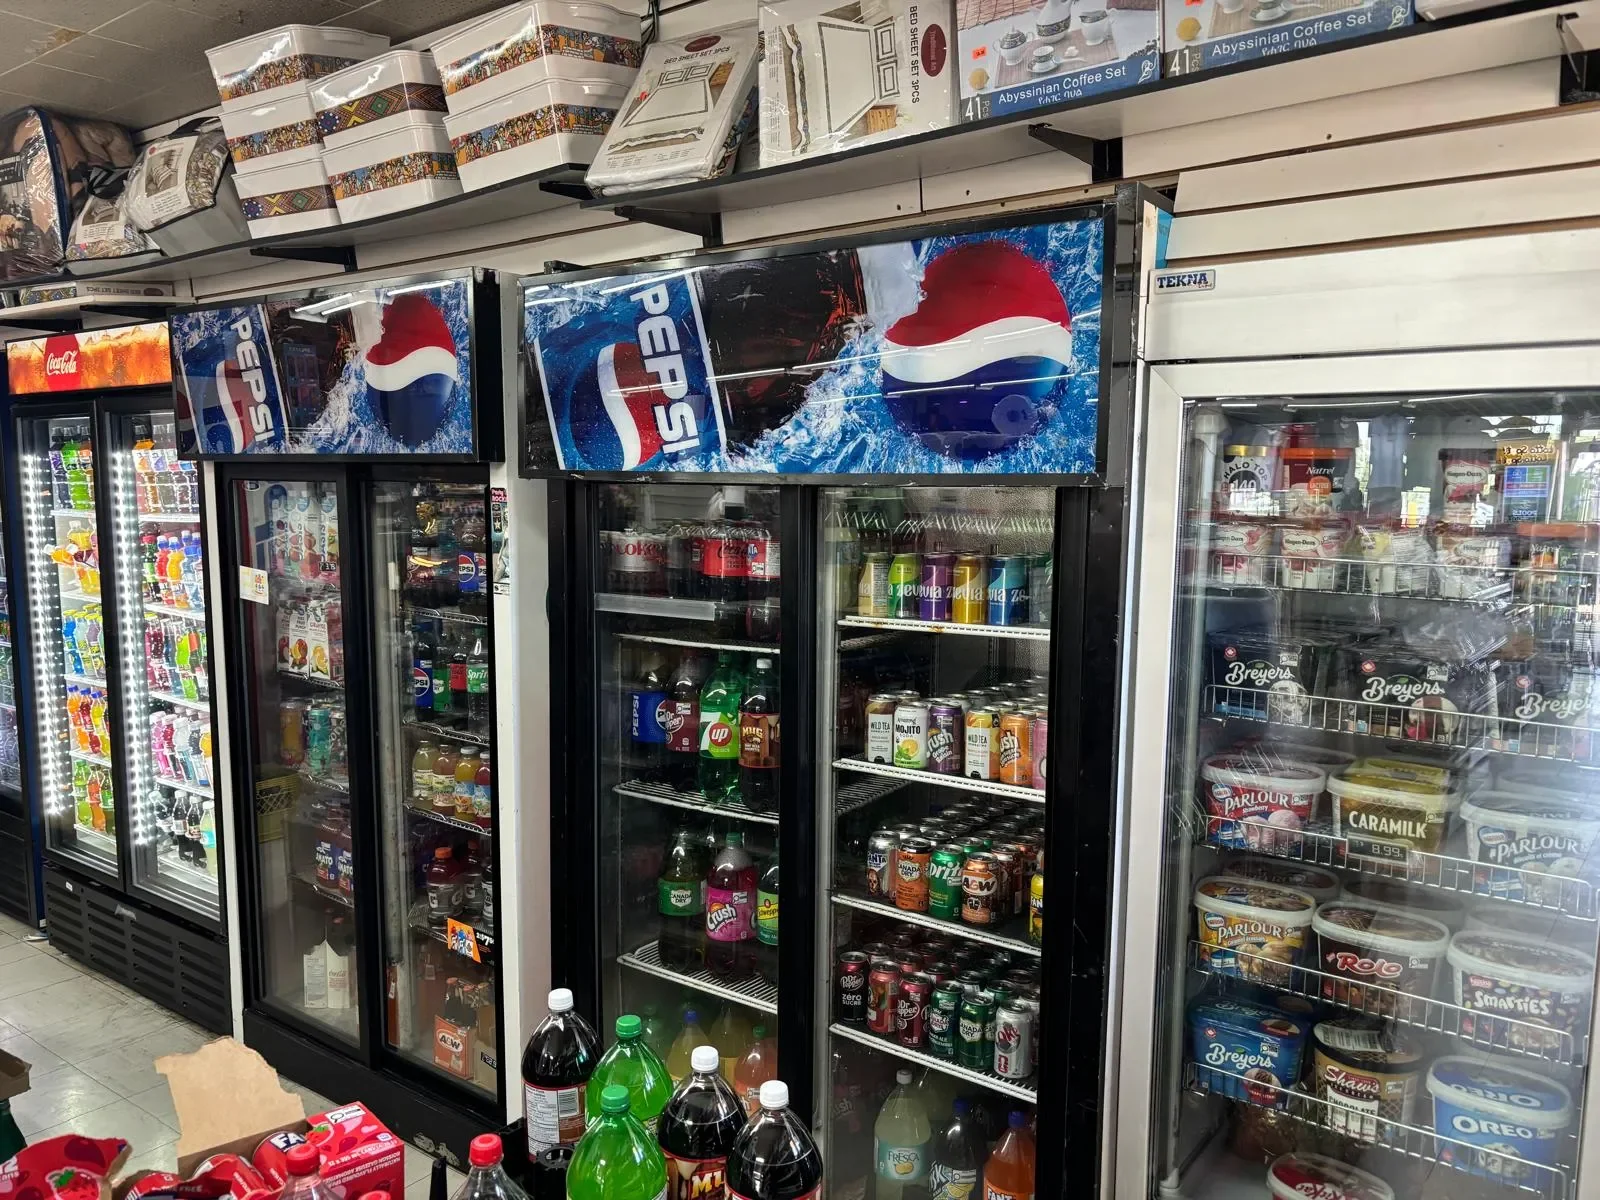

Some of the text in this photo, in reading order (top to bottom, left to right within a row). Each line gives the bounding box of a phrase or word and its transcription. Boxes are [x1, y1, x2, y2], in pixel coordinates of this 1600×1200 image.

[1211, 12, 1372, 57] Abyssinian Coffee Set
[664, 57, 677, 65] BED
[678, 52, 699, 62] SHEET
[910, 5, 920, 104] BED SHEET SET 3PCS
[1169, 49, 1190, 76] 41
[998, 65, 1127, 105] Abyssinian Coffee Set
[965, 96, 982, 121] 41
[1156, 272, 1208, 288] TEKNA
[230, 316, 276, 442] PEPSI
[630, 283, 700, 454] PEPSI
[1224, 461, 1268, 482] HALO TOP
[1306, 466, 1336, 475] Natrel
[1224, 662, 1296, 686] Breyers
[1362, 676, 1446, 702] Breyers
[632, 695, 640, 736] PEPSI
[870, 722, 890, 730] WILD TEA
[742, 726, 763, 739] MUG
[896, 724, 921, 734] MOJITO
[979, 735, 987, 744] TEA
[1224, 791, 1290, 816] PARLOUR
[1349, 810, 1428, 839] CARAMILK
[1372, 844, 1400, 857] 8.99
[1496, 836, 1581, 864] PARLOUR
[963, 876, 996, 892] A&W
[428, 892, 438, 909] G
[706, 903, 736, 930] Crush
[1218, 922, 1282, 944] PARLOUR
[1336, 952, 1403, 979] Rolo
[440, 1033, 460, 1050] A&W
[1205, 1043, 1275, 1069] Breyers
[1325, 1064, 1380, 1094] Shaw's
[1450, 1084, 1542, 1107] OREO
[1452, 1115, 1533, 1139] OREO
[889, 1151, 919, 1162] FRESCA
